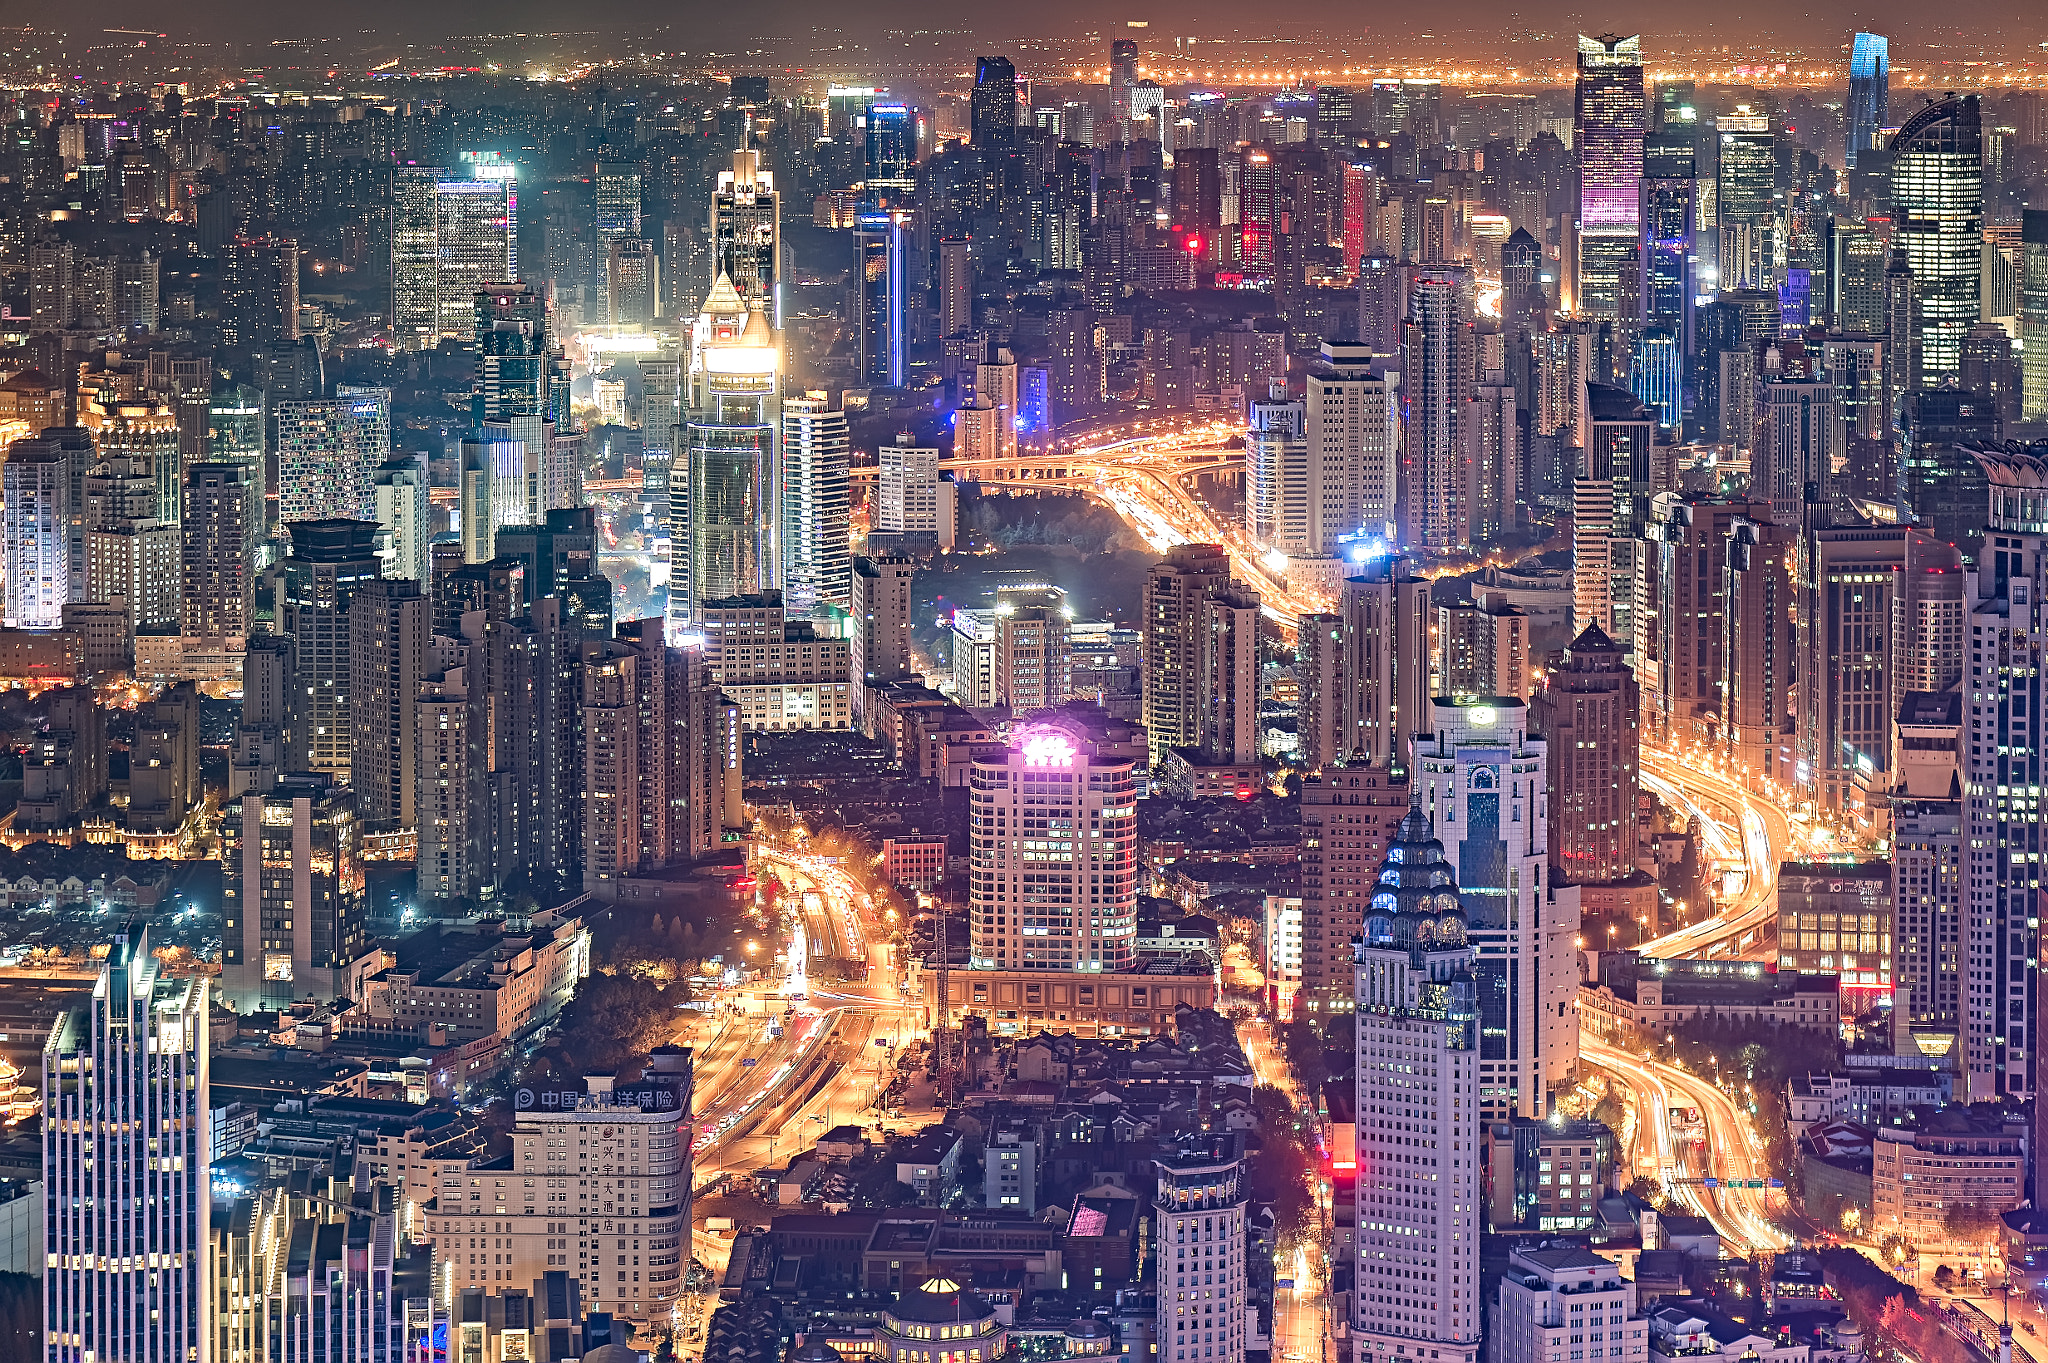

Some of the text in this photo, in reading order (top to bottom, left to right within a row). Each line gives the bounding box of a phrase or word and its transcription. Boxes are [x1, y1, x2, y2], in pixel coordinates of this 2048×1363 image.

[541, 1089, 674, 1109] 中国太平洋保险
[602, 1145, 615, 1232] 兴宇大酒店
